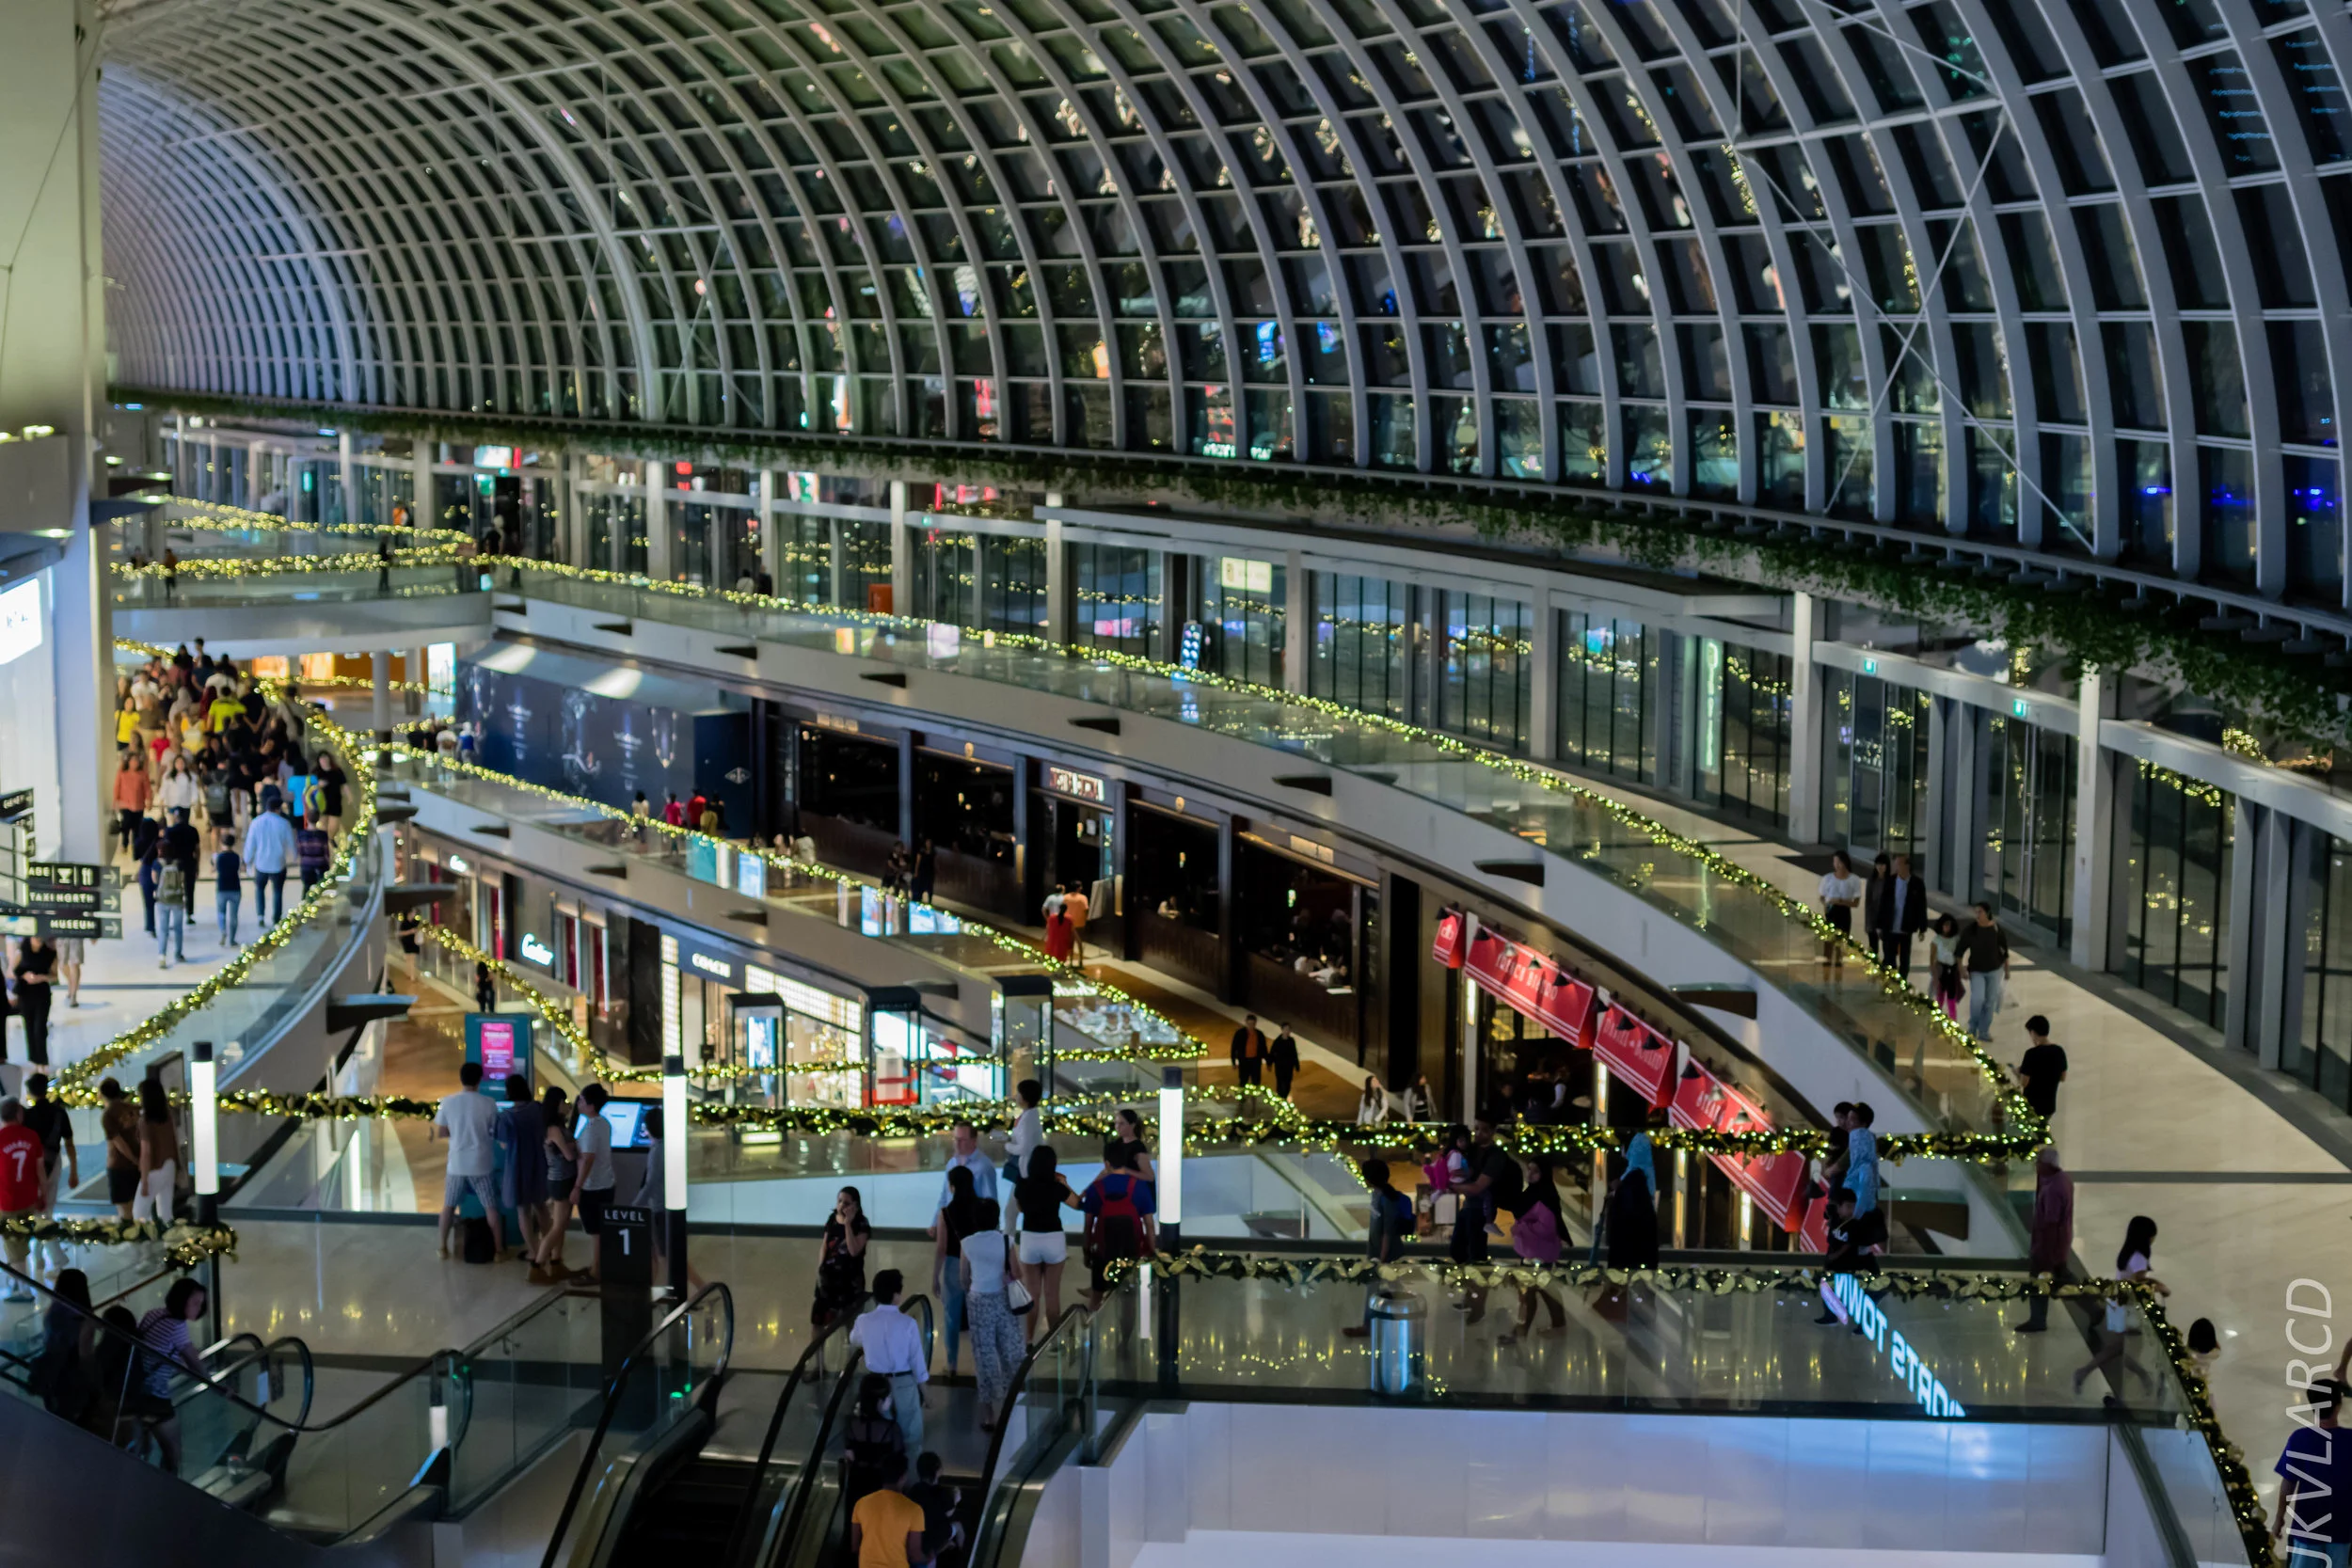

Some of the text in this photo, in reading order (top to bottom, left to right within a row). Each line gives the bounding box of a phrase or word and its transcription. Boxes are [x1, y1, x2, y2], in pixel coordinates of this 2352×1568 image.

[29, 892, 95, 904] TAXI NORTH
[50, 919, 96, 929] MUSEUM
[12, 1150, 26, 1182] 7
[604, 1210, 645, 1222] LEVEL
[618, 1228, 629, 1256] 1
